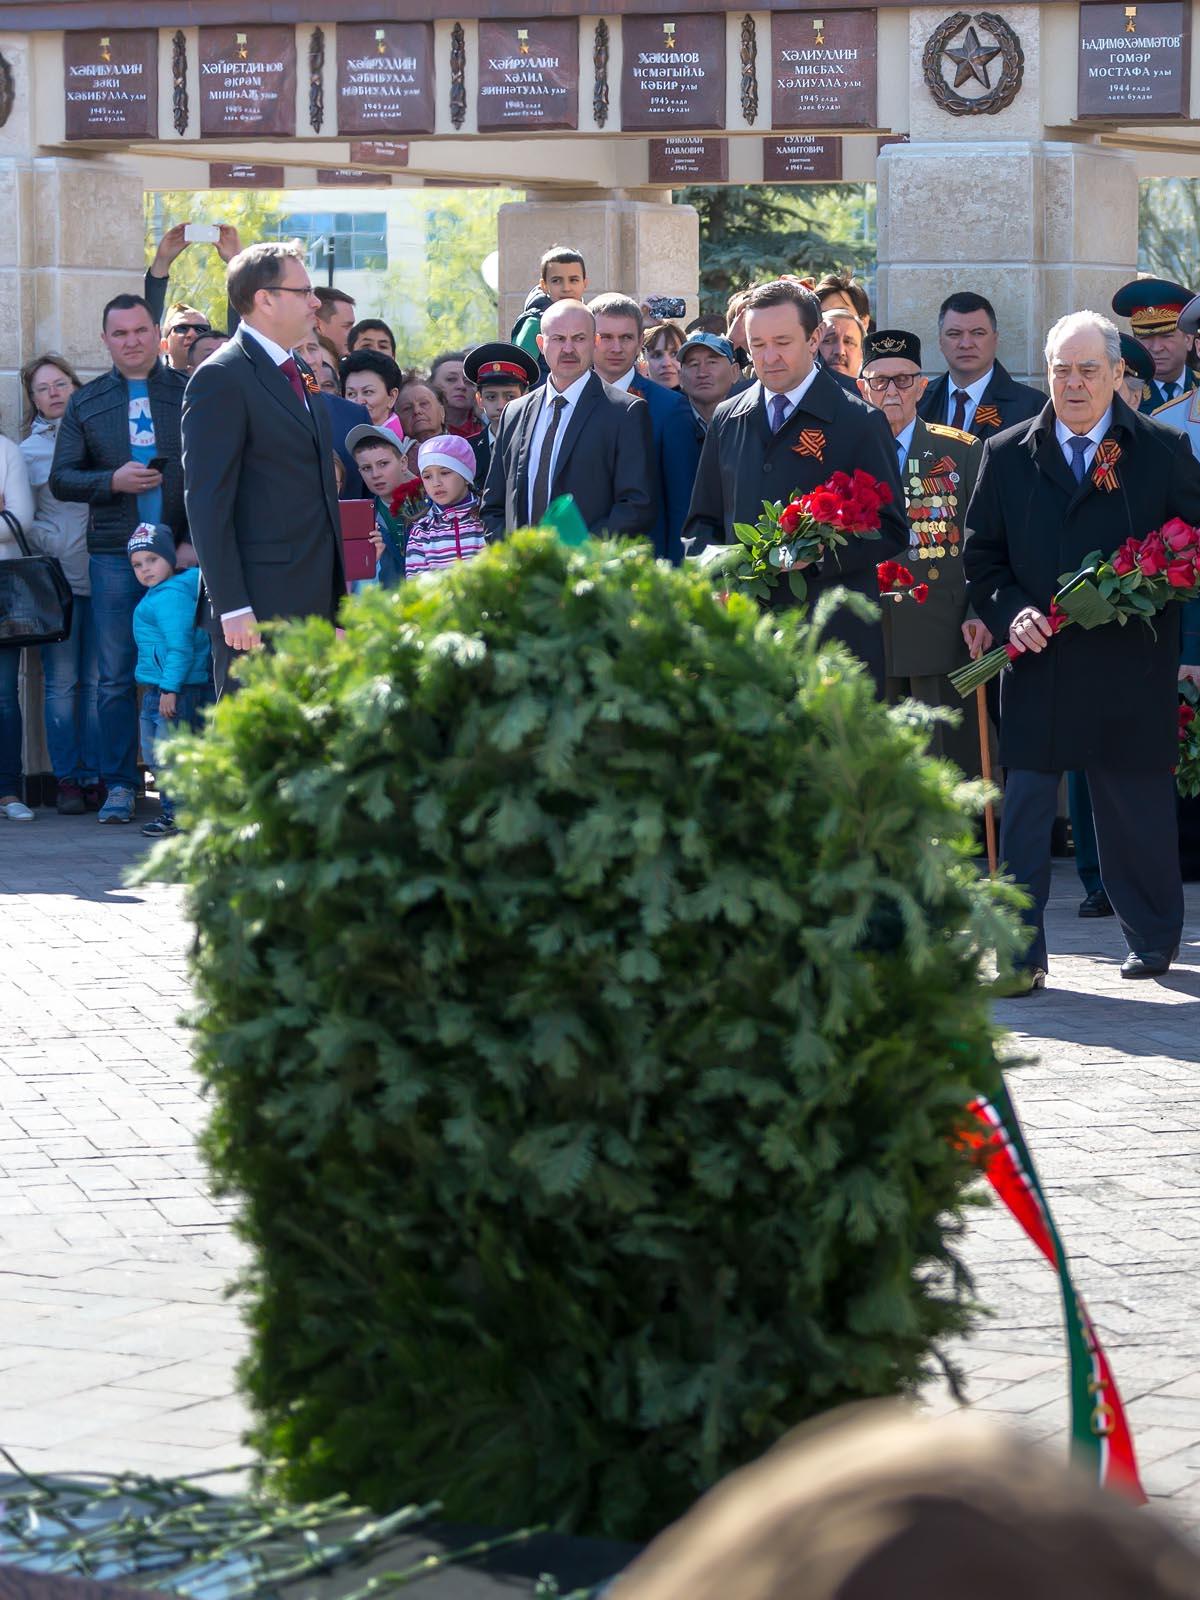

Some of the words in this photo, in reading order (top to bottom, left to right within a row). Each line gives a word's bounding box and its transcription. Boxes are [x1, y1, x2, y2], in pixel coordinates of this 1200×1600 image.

[638, 52, 700, 64] ХӘКИМОВ
[782, 49, 858, 61] ХӘЛИУЛЛИН
[1110, 53, 1151, 63] ГОМӘР
[202, 60, 284, 74] ХӘЙРЕТДИНОВ
[489, 56, 559, 70] ХӘЙРУЛЛИН
[633, 65, 704, 77] ИСМӘГЫЙЛЬ
[794, 65, 844, 74] МИСБАХ
[1088, 67, 1150, 77] МОСТАФА
[1153, 70, 1172, 78] улы
[640, 80, 678, 90] КӘБИР
[680, 84, 698, 92] улы
[778, 78, 842, 88] ХӘЛИУЛЛА
[844, 80, 862, 88] улы
[481, 86, 549, 96] ЗИННӘТУЛЛА
[800, 94, 819, 102] 1945
[664, 146, 704, 154] ПАВЛОВИЧ
[776, 146, 824, 154] ХАМИТОВИЧ
